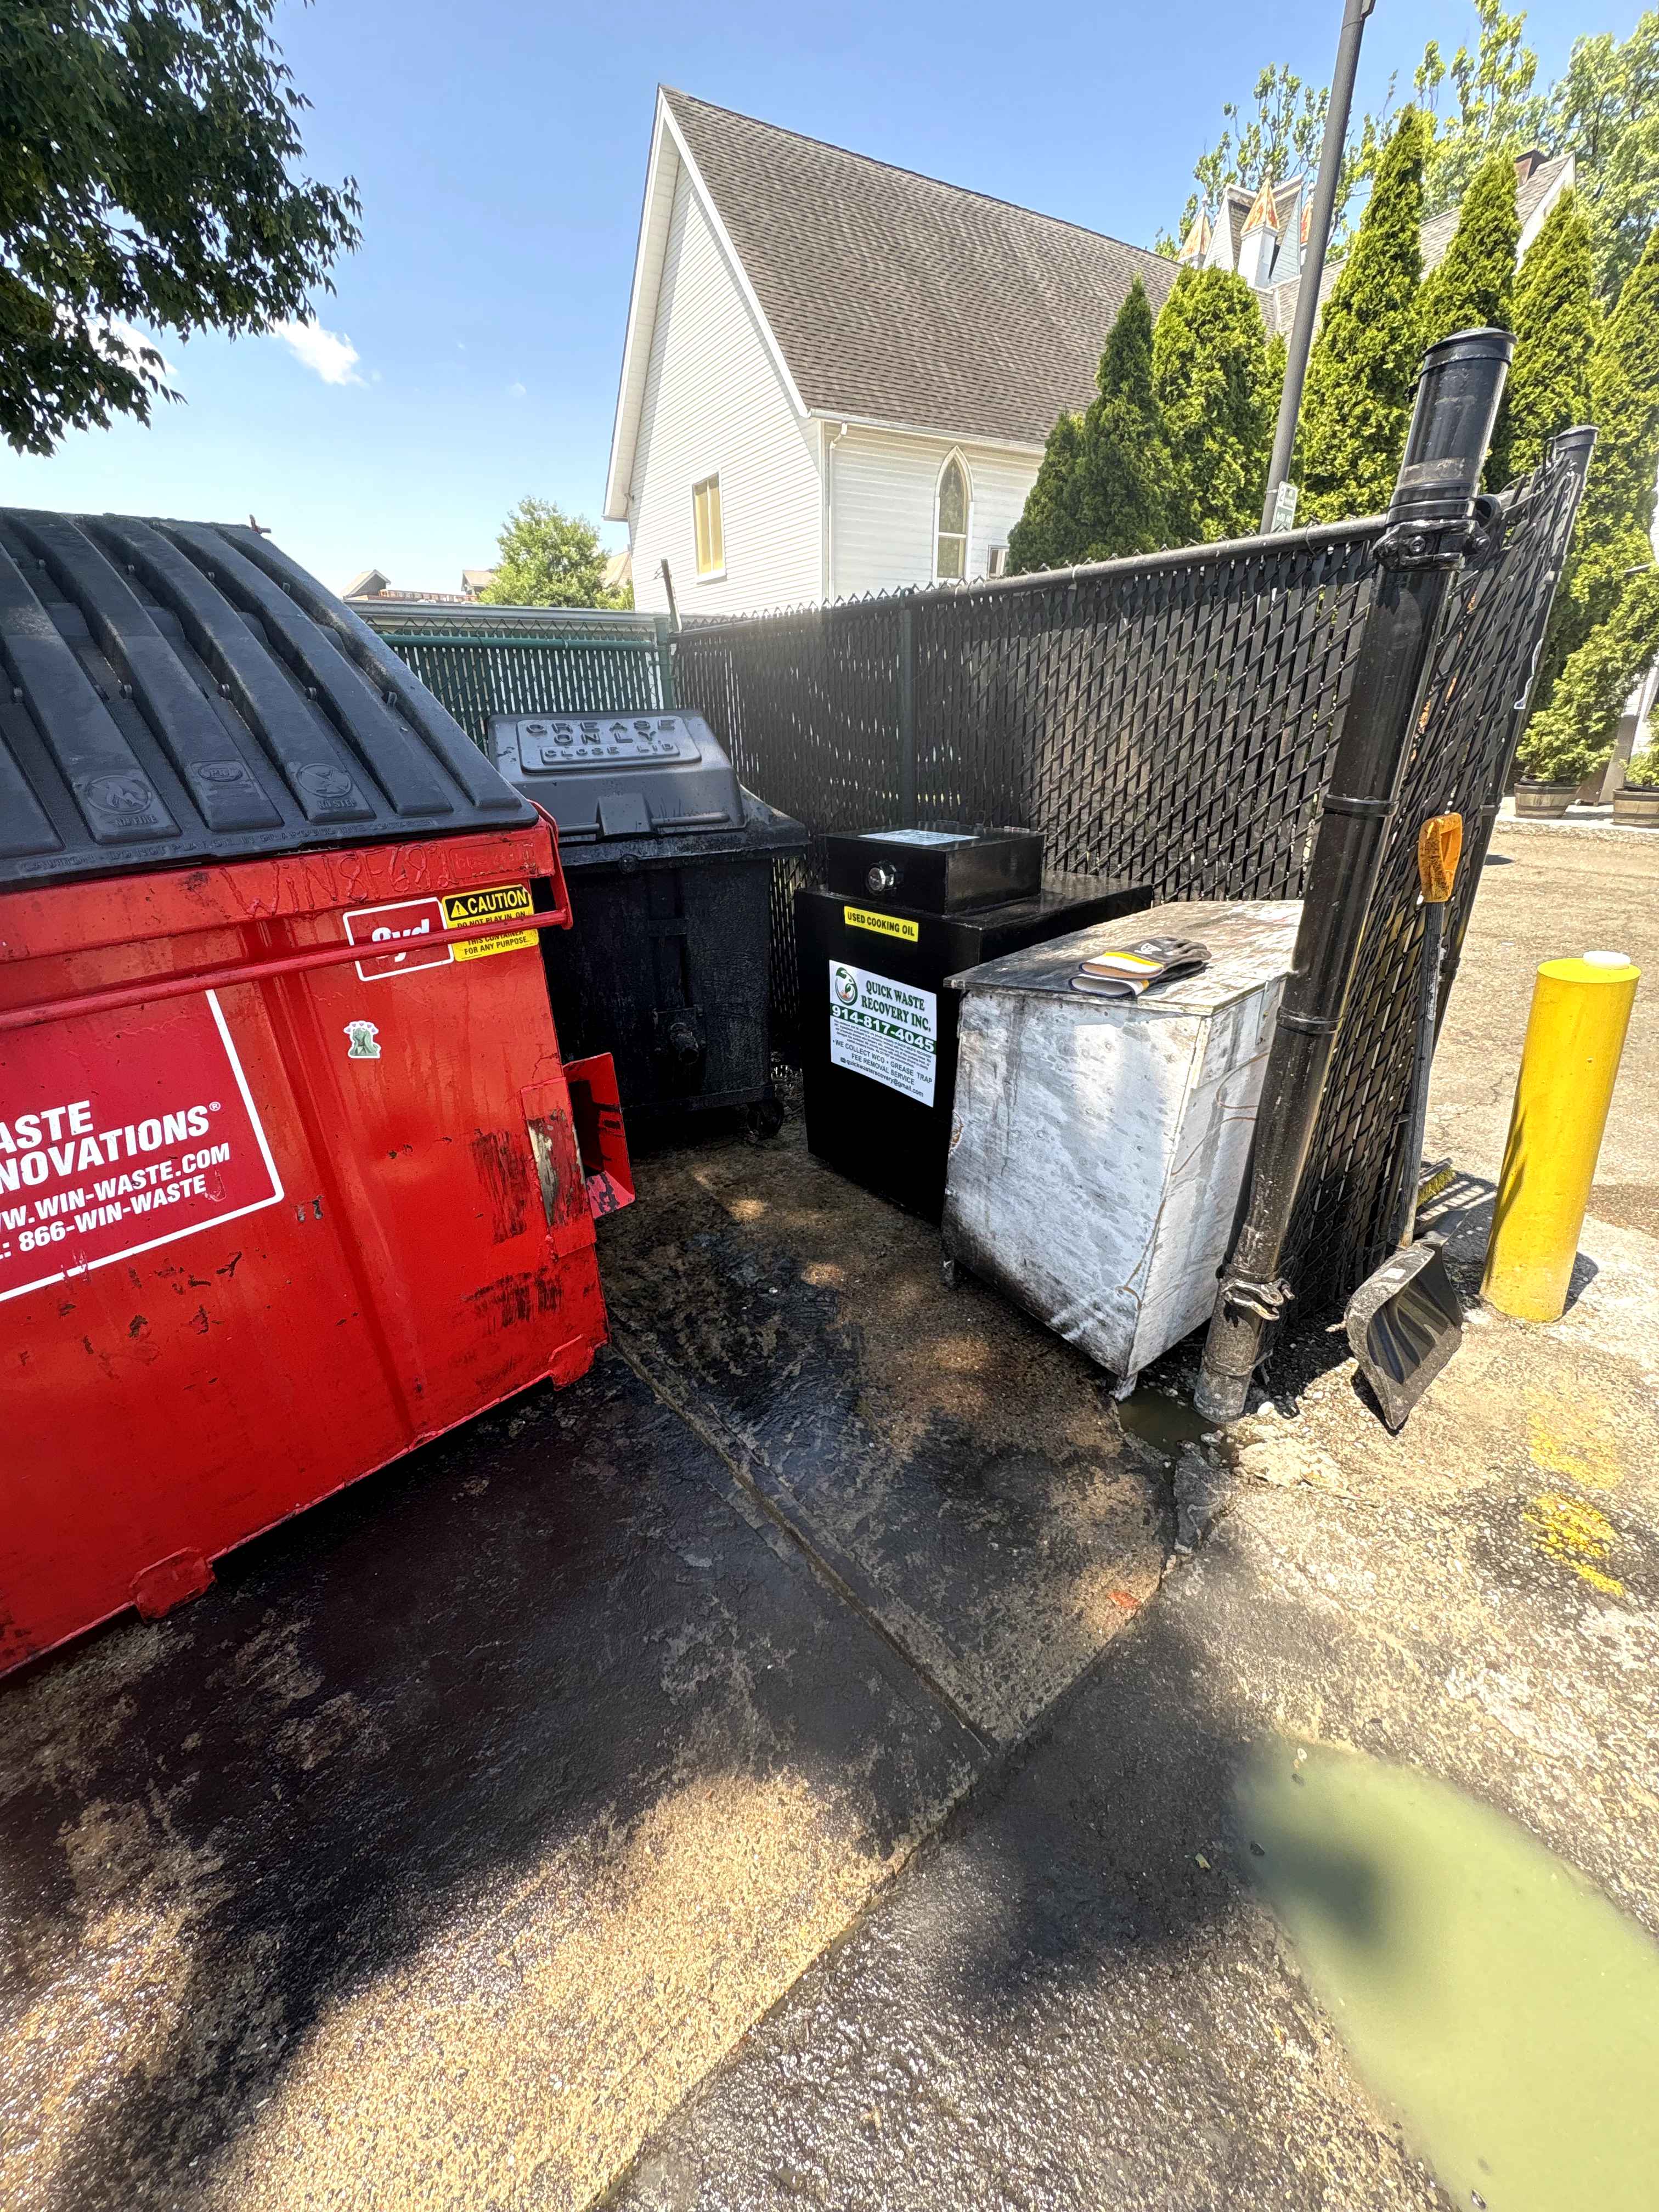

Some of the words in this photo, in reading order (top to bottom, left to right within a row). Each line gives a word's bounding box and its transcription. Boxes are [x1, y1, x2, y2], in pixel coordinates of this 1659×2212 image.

[526, 719, 676, 736] GREASE
[554, 731, 656, 745] ONLY
[544, 746, 620, 759] CLOSE
[637, 742, 674, 754] LID
[467, 889, 528, 915] CAUTION
[468, 938, 483, 946] THIS
[485, 930, 524, 942] CONTAINER
[847, 911, 865, 923] USED
[867, 916, 900, 933] COOKING
[902, 925, 915, 936] OIL
[464, 946, 478, 955] FOR
[480, 943, 494, 952] ANY
[496, 936, 527, 949] PURPOSE
[866, 979, 892, 1002] QUICK
[894, 989, 925, 1012] WASTE
[832, 1002, 934, 1054] 914-817-4045
[861, 994, 909, 1024] RECOVERY
[911, 1013, 931, 1032] INC.
[835, 1039, 843, 1048] WE
[845, 1041, 870, 1058] COLLECT
[871, 1052, 884, 1064] WCO
[890, 1060, 913, 1076] GREASE
[916, 1071, 932, 1085] TRAP
[846, 1057, 923, 1098] quickwasterecovery@gmail.com
[851, 1052, 861, 1063] FEE
[863, 1057, 889, 1074] REMOVAL
[890, 1069, 915, 1086] SERVICE
[0, 1100, 93, 1153] ASTE
[0, 1142, 230, 1233] W.WIN-WASTE.COM
[18, 1173, 207, 1252] 866-WIN-WASTE
